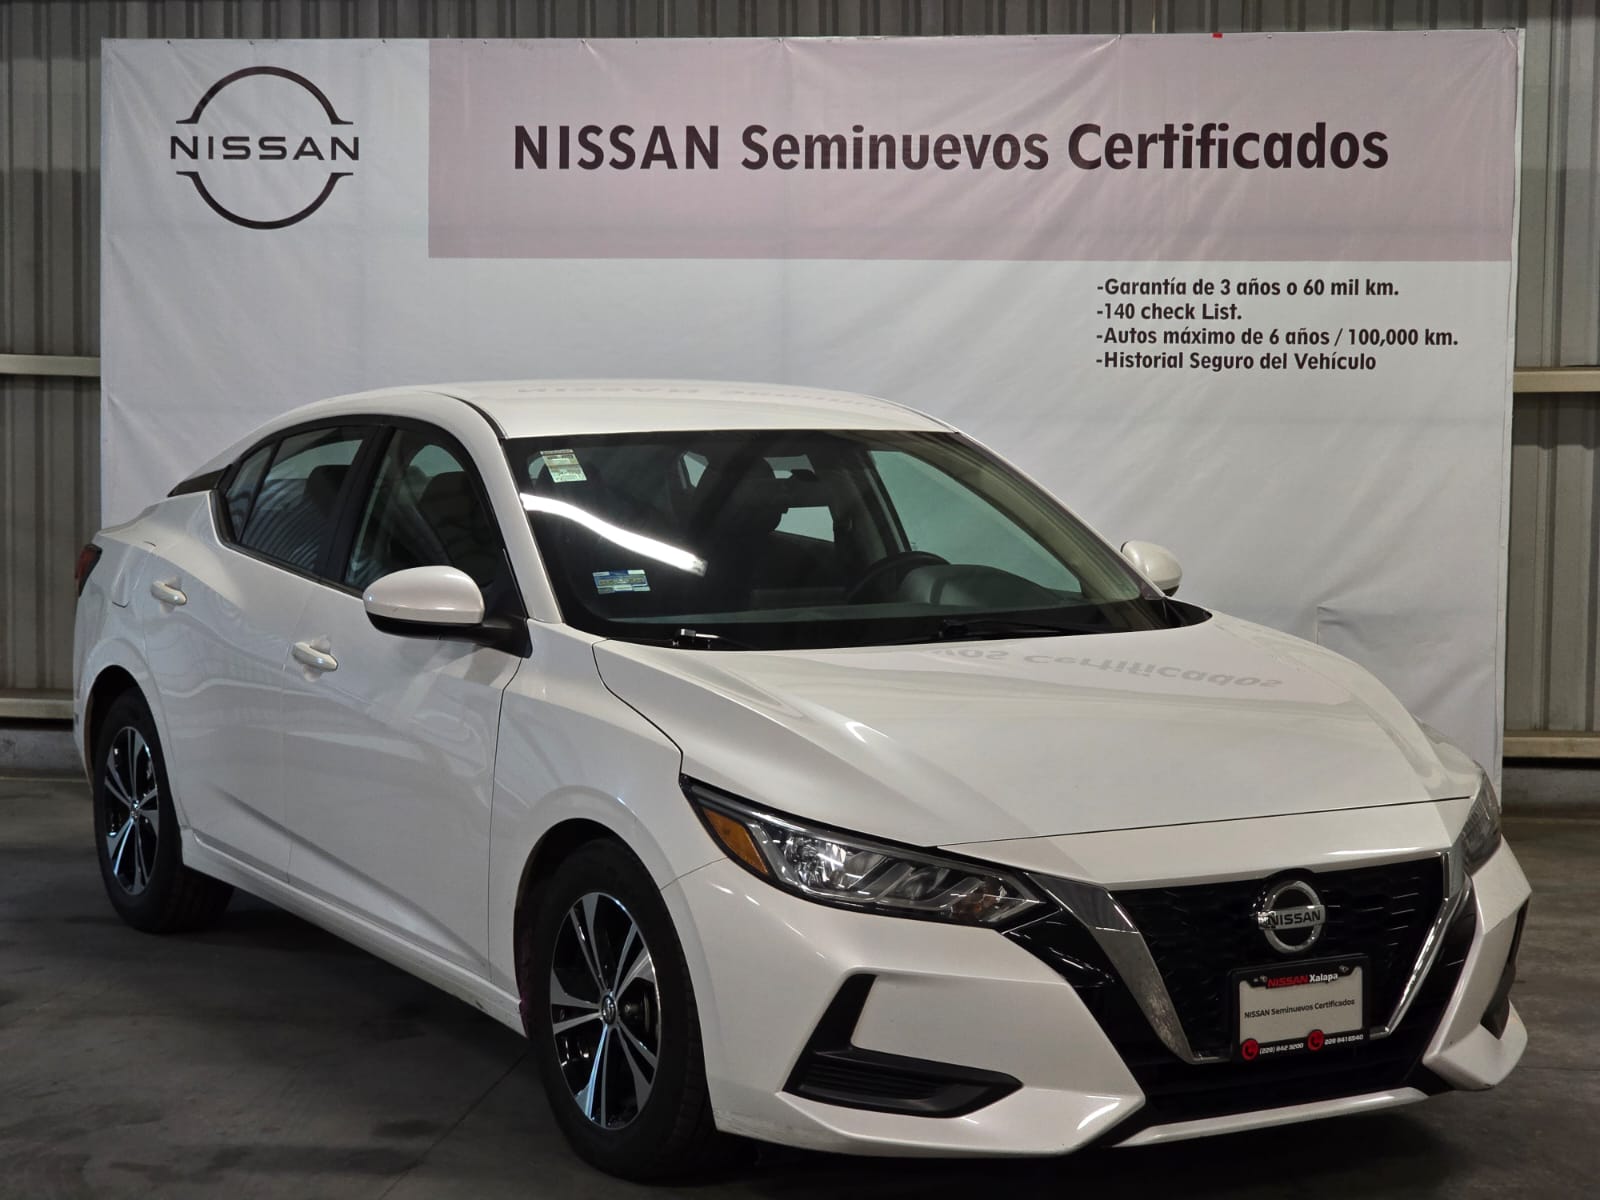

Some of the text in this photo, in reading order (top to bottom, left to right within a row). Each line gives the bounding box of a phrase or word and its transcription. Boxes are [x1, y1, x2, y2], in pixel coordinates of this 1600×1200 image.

[170, 135, 360, 161] NISSAN
[514, 121, 1389, 170] NISSAN Seminuevos Certificados
[1097, 277, 1399, 296] -Garantía de 3 años o 60 mil km.
[1096, 302, 1242, 321] -140 check List.
[1096, 326, 1458, 347] -Autos máximo de 6 años / 100,000 km.
[1096, 351, 1377, 373] -Historial Seguro del Vehículo
[1268, 909, 1321, 926] NISSAN
[1268, 973, 1339, 988] NISSAN Xalapa
[1244, 999, 1355, 1019] NISSAN Seminuevos Certificados
